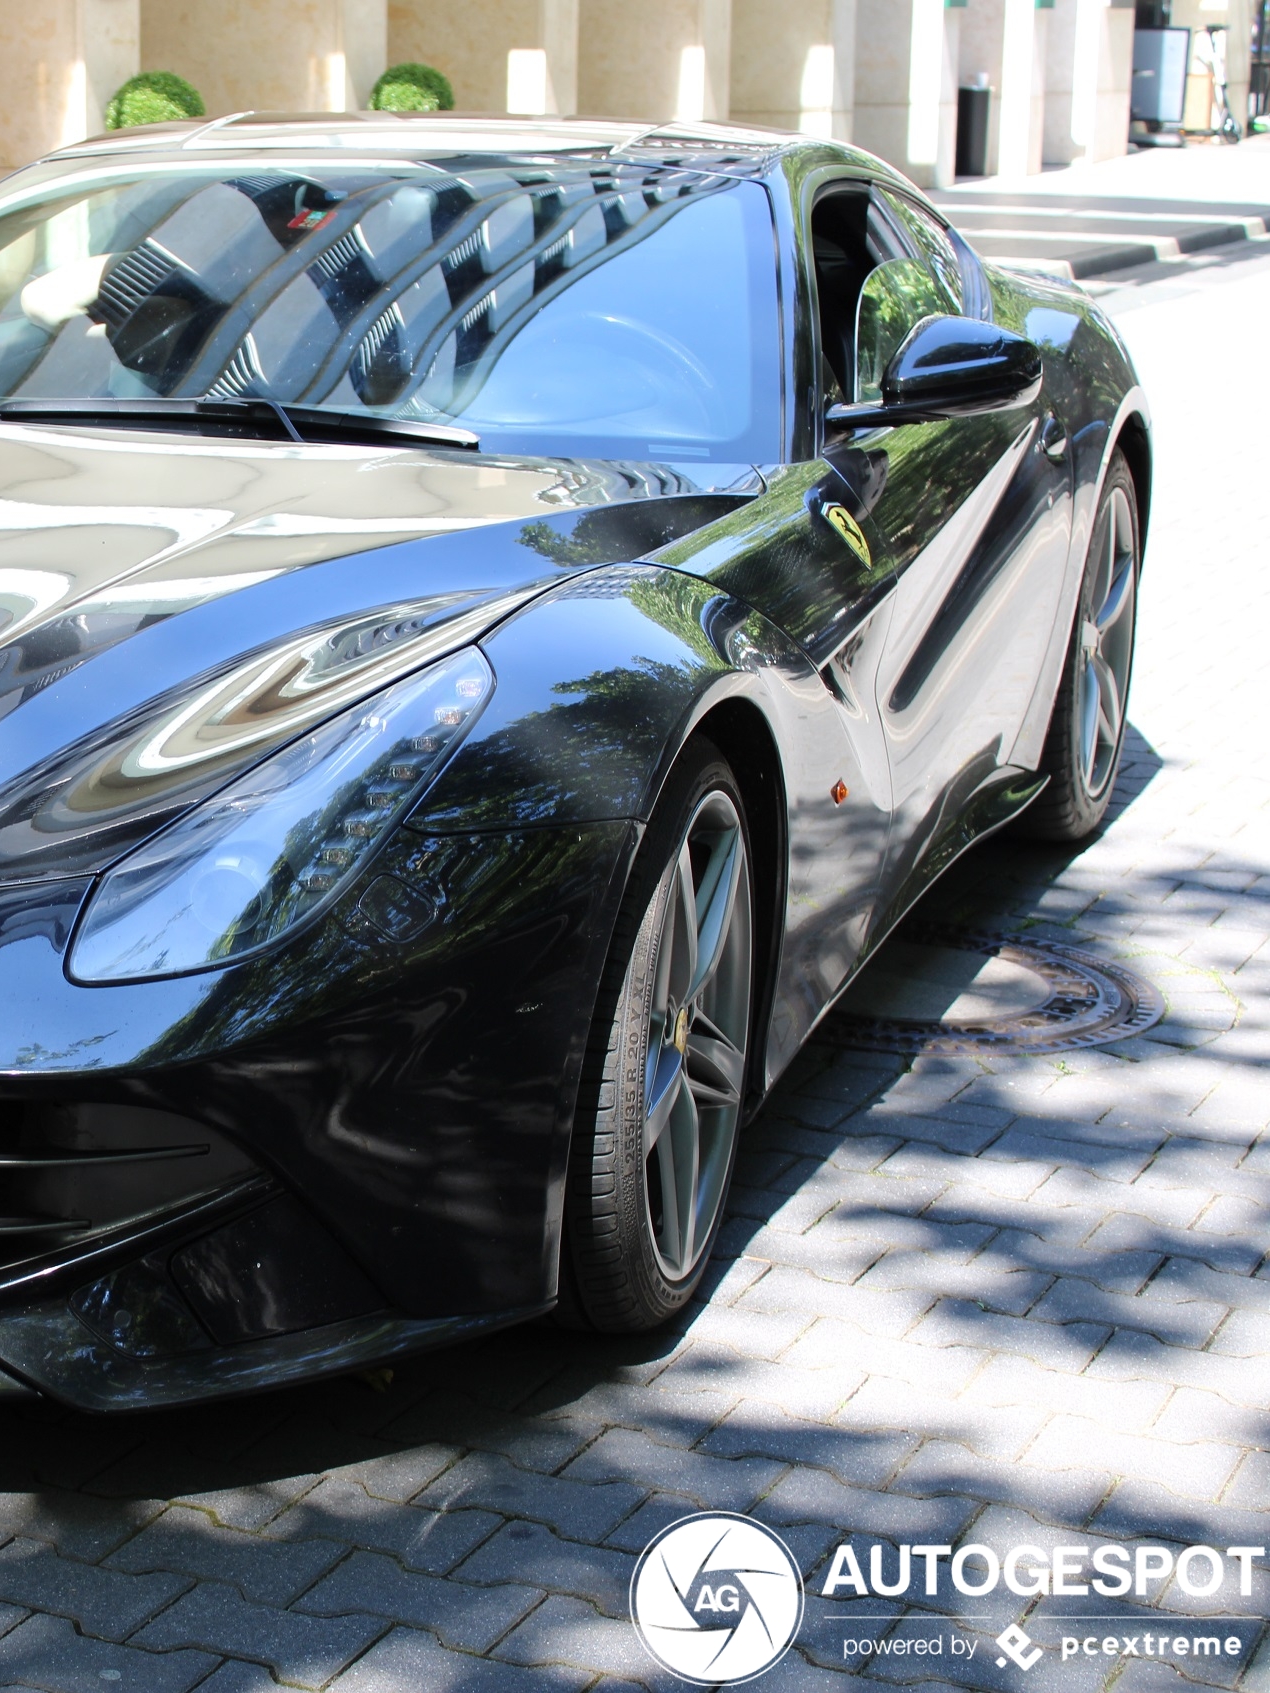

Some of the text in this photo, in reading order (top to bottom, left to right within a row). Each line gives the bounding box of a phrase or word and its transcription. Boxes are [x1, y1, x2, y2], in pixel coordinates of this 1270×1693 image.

[624, 973, 647, 1164] 255/35 R 20 Y XL
